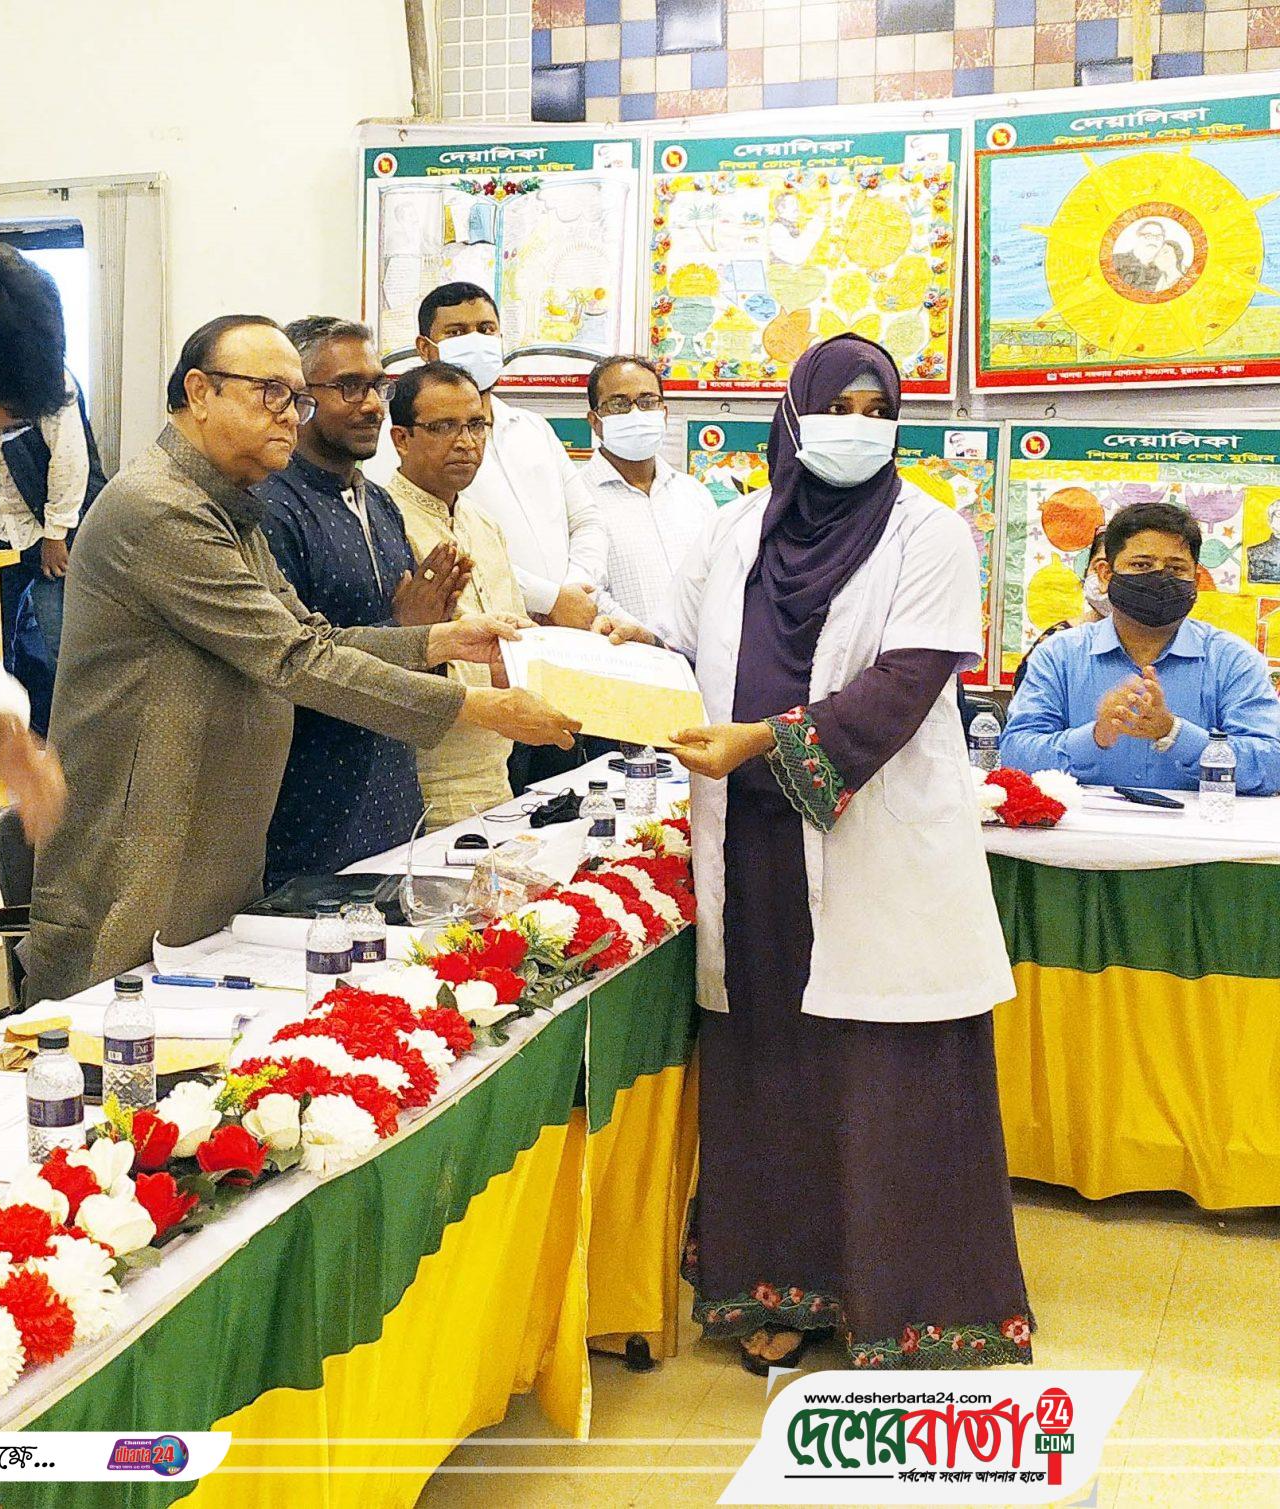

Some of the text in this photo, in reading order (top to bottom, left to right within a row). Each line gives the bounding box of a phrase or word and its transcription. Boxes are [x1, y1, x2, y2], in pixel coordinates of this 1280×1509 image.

[1070, 107, 1211, 131] দেয়ালিকা
[439, 147, 549, 163] দেয়ালিকা
[733, 139, 855, 157] দেয়ালিকা
[1104, 431, 1243, 449] দেয়ালিকা
[1086, 450, 1278, 464] শিশুর চোখে শেখ মুজিব
